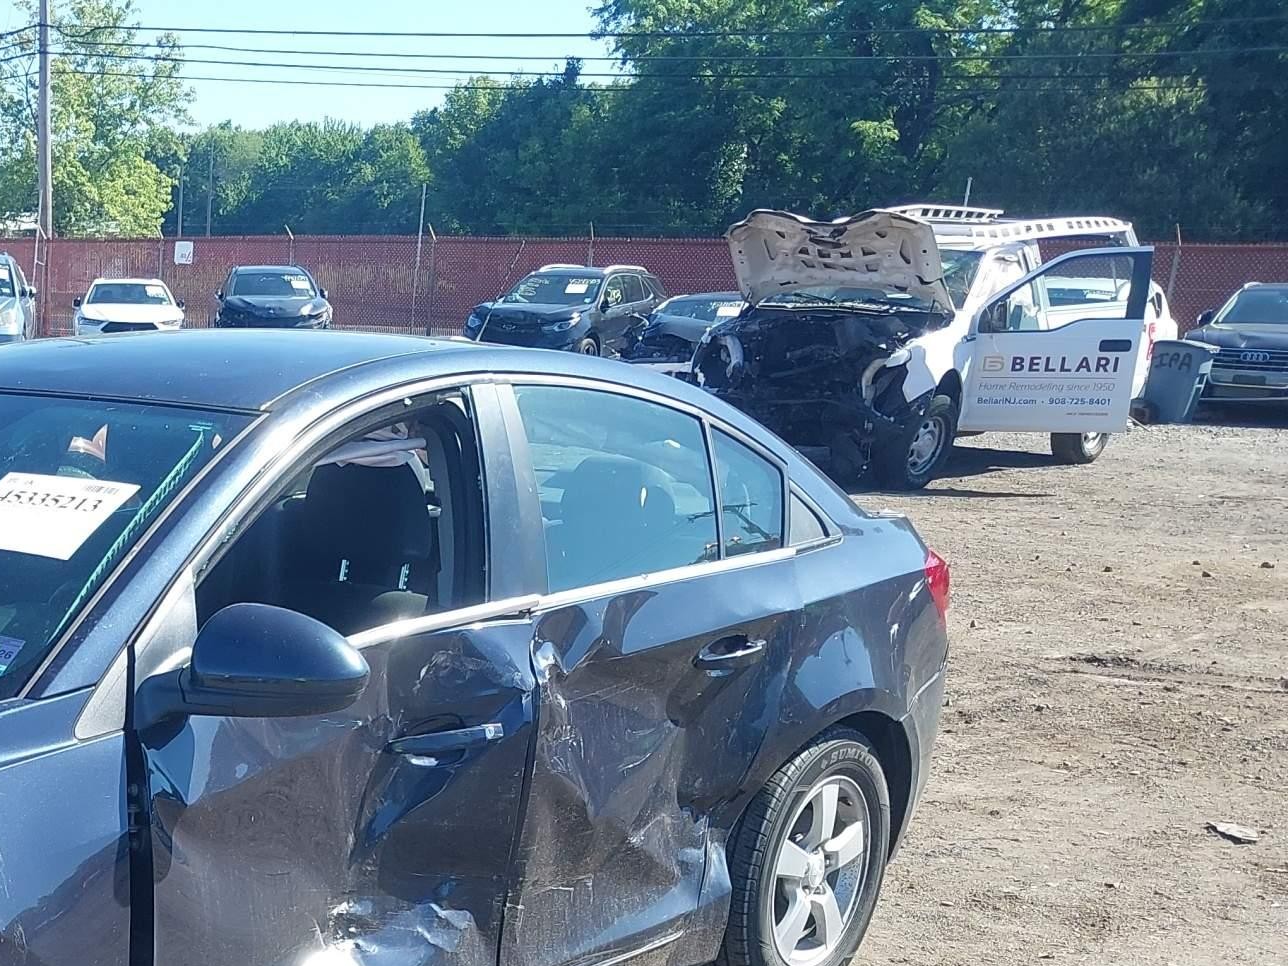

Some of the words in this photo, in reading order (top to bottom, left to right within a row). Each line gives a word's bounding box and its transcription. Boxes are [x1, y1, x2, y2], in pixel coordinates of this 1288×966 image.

[1011, 356, 1120, 373] BELLARI
[978, 382, 1007, 391] Home
[1008, 381, 1063, 393] Remodeling
[1066, 382, 1091, 391] since
[1093, 383, 1116, 392] 1950
[977, 397, 1037, 405] BellariNJ.com
[1047, 397, 1111, 406] 908-725-8401
